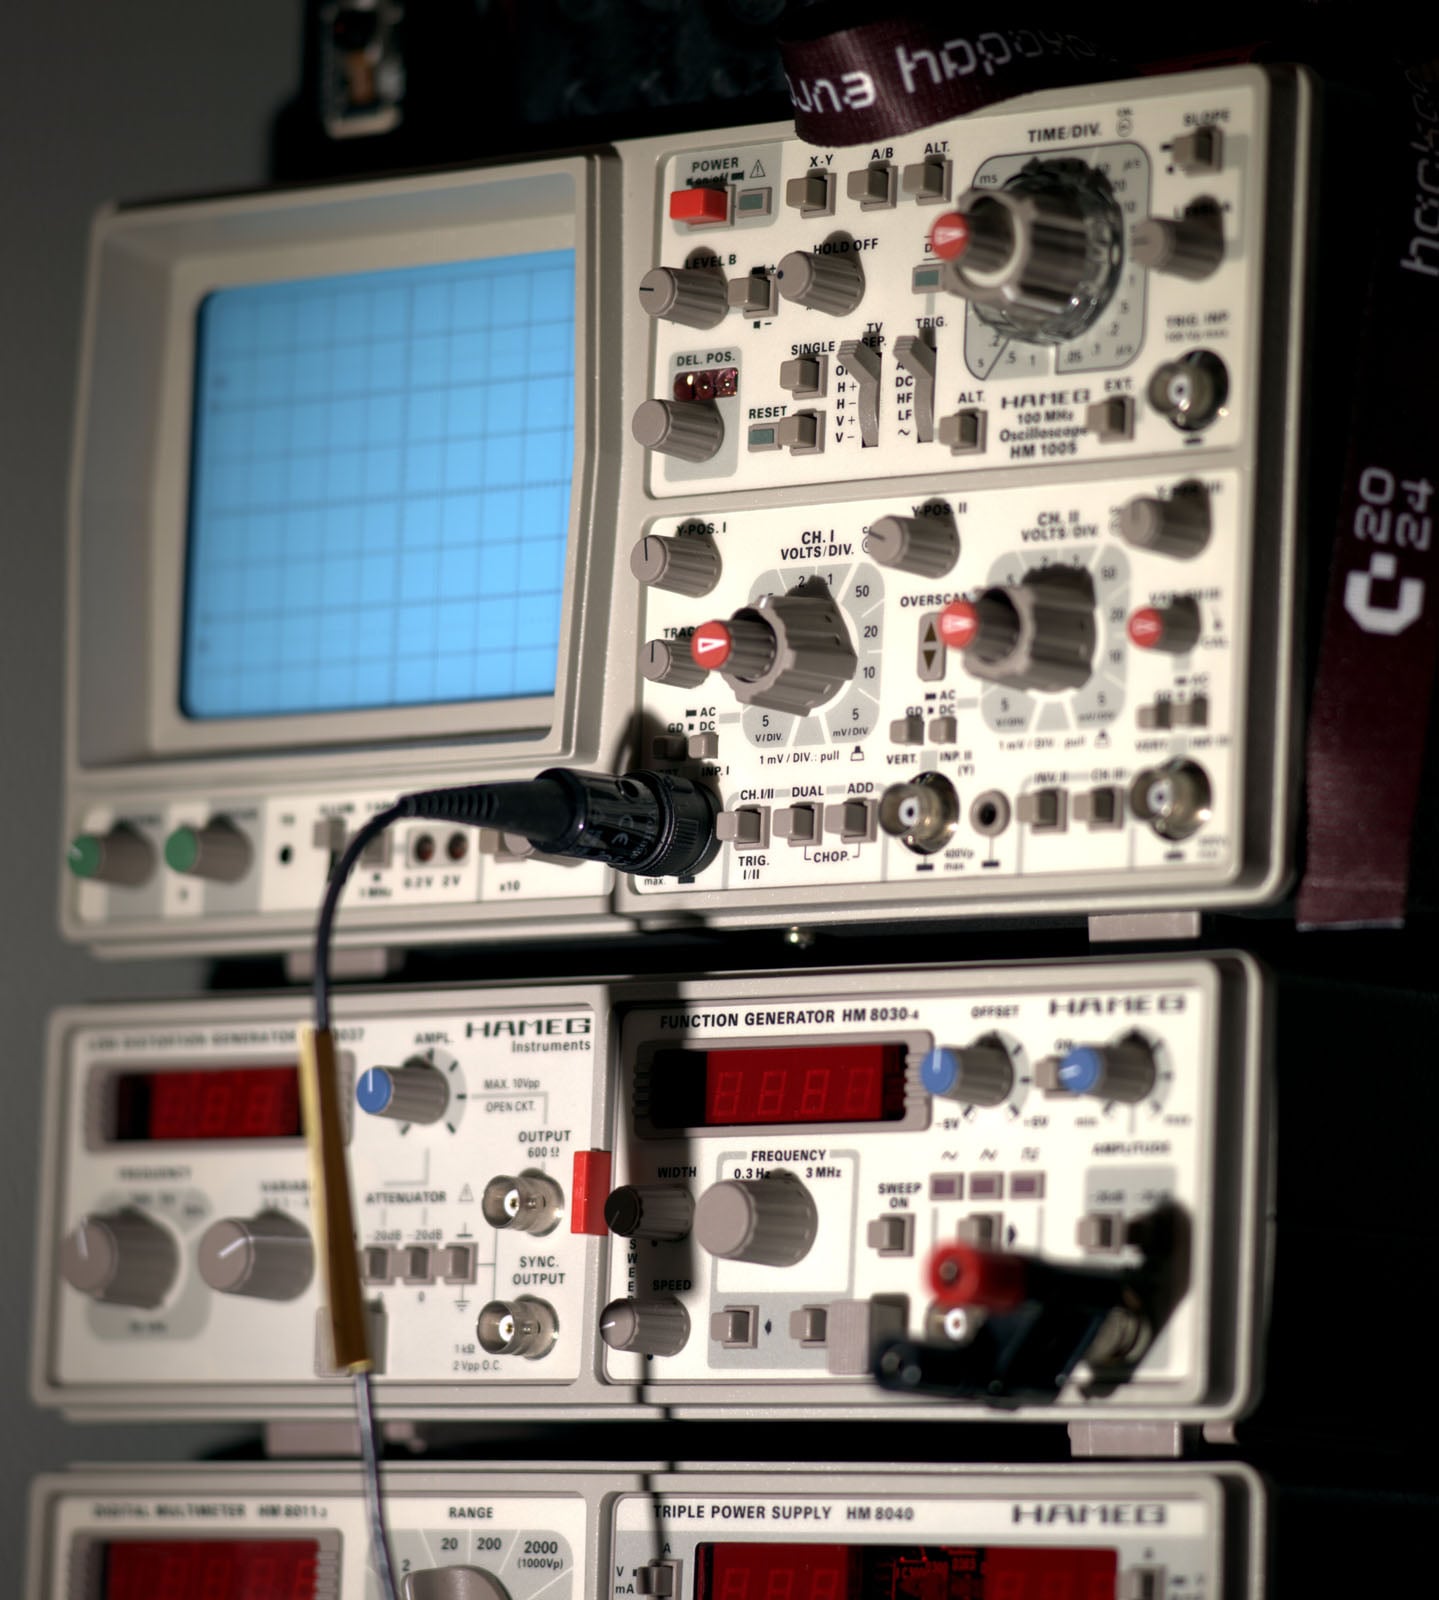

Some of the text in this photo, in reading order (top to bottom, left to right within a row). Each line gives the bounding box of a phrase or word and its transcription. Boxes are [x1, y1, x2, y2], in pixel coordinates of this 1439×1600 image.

[871, 148, 894, 160] A/B
[924, 142, 950, 155] ALT.
[692, 157, 739, 173] POWER
[979, 173, 998, 184] ms
[813, 238, 879, 256] HOLD OFF
[685, 254, 737, 270] LEVEL B
[866, 322, 883, 334] TV
[915, 317, 948, 329] TRIG.
[791, 341, 835, 356] SINGLE
[861, 336, 887, 348] SEP.
[677, 352, 736, 367] DEL. POS.
[895, 376, 914, 388] DC
[896, 393, 913, 404] HF
[958, 391, 985, 404] ALT.
[1001, 389, 1091, 409] HAMEG
[748, 406, 787, 419] RESET
[897, 409, 913, 421] LF
[1017, 411, 1073, 425] 100 MHz
[1010, 443, 1078, 459] HM 1005
[677, 523, 719, 537] Y-POS.
[801, 530, 835, 545] CH. I
[781, 544, 855, 560] VOLTS/DIV.
[855, 585, 870, 598] 50
[663, 626, 696, 639] TRAC
[863, 626, 878, 638] 20
[863, 667, 876, 679] 10
[940, 690, 956, 700] AC
[700, 707, 716, 718] AC
[852, 709, 859, 720] 5
[939, 704, 956, 715] DC
[667, 722, 716, 733] GD DC
[762, 715, 769, 727] 5
[767, 754, 784, 765] mV
[820, 750, 840, 763] pull
[701, 765, 723, 777] INP.
[791, 785, 824, 798] DUAL
[847, 782, 874, 795] ADD
[739, 856, 770, 868] TRIG.
[813, 851, 849, 863] CHOP.
[743, 869, 760, 881] I/II
[1049, 994, 1187, 1016] HAMEG
[660, 1013, 739, 1029] FUNCTION
[744, 1009, 835, 1026] GENERATOR
[842, 1008, 866, 1021] HM
[971, 1005, 1020, 1019] OFFSET
[465, 1018, 591, 1038] HAMEG
[512, 1040, 591, 1053] Instruments
[484, 1079, 510, 1090] MAX.
[486, 1101, 513, 1113] OPEN
[518, 1129, 572, 1143] OUTPUT
[528, 1147, 548, 1158] 600
[751, 1149, 827, 1163] FREQUENCY
[657, 1166, 697, 1179] WIDTH
[734, 1166, 842, 1180] 0.3 Hz 3 MHz
[878, 1182, 922, 1195] SWEEP
[365, 1191, 447, 1204] ATTENUATOR
[889, 1197, 909, 1209] ON
[520, 1256, 560, 1268] SYNC.
[512, 1272, 567, 1286] OUTPUT
[652, 1279, 692, 1292] SPEED
[453, 1361, 460, 1371] 2
[258, 1503, 281, 1518] HM
[449, 1507, 494, 1519] RANGE
[655, 1505, 914, 1521] TRIPLE POWER SUPPLY HM 8040
[1011, 1504, 1167, 1524] HAMEG
[441, 1537, 559, 1555] 20 200 2000
[663, 1542, 672, 1555] A
[402, 1559, 411, 1572] 2
[616, 1565, 625, 1578] V
[615, 1583, 635, 1595] mA
